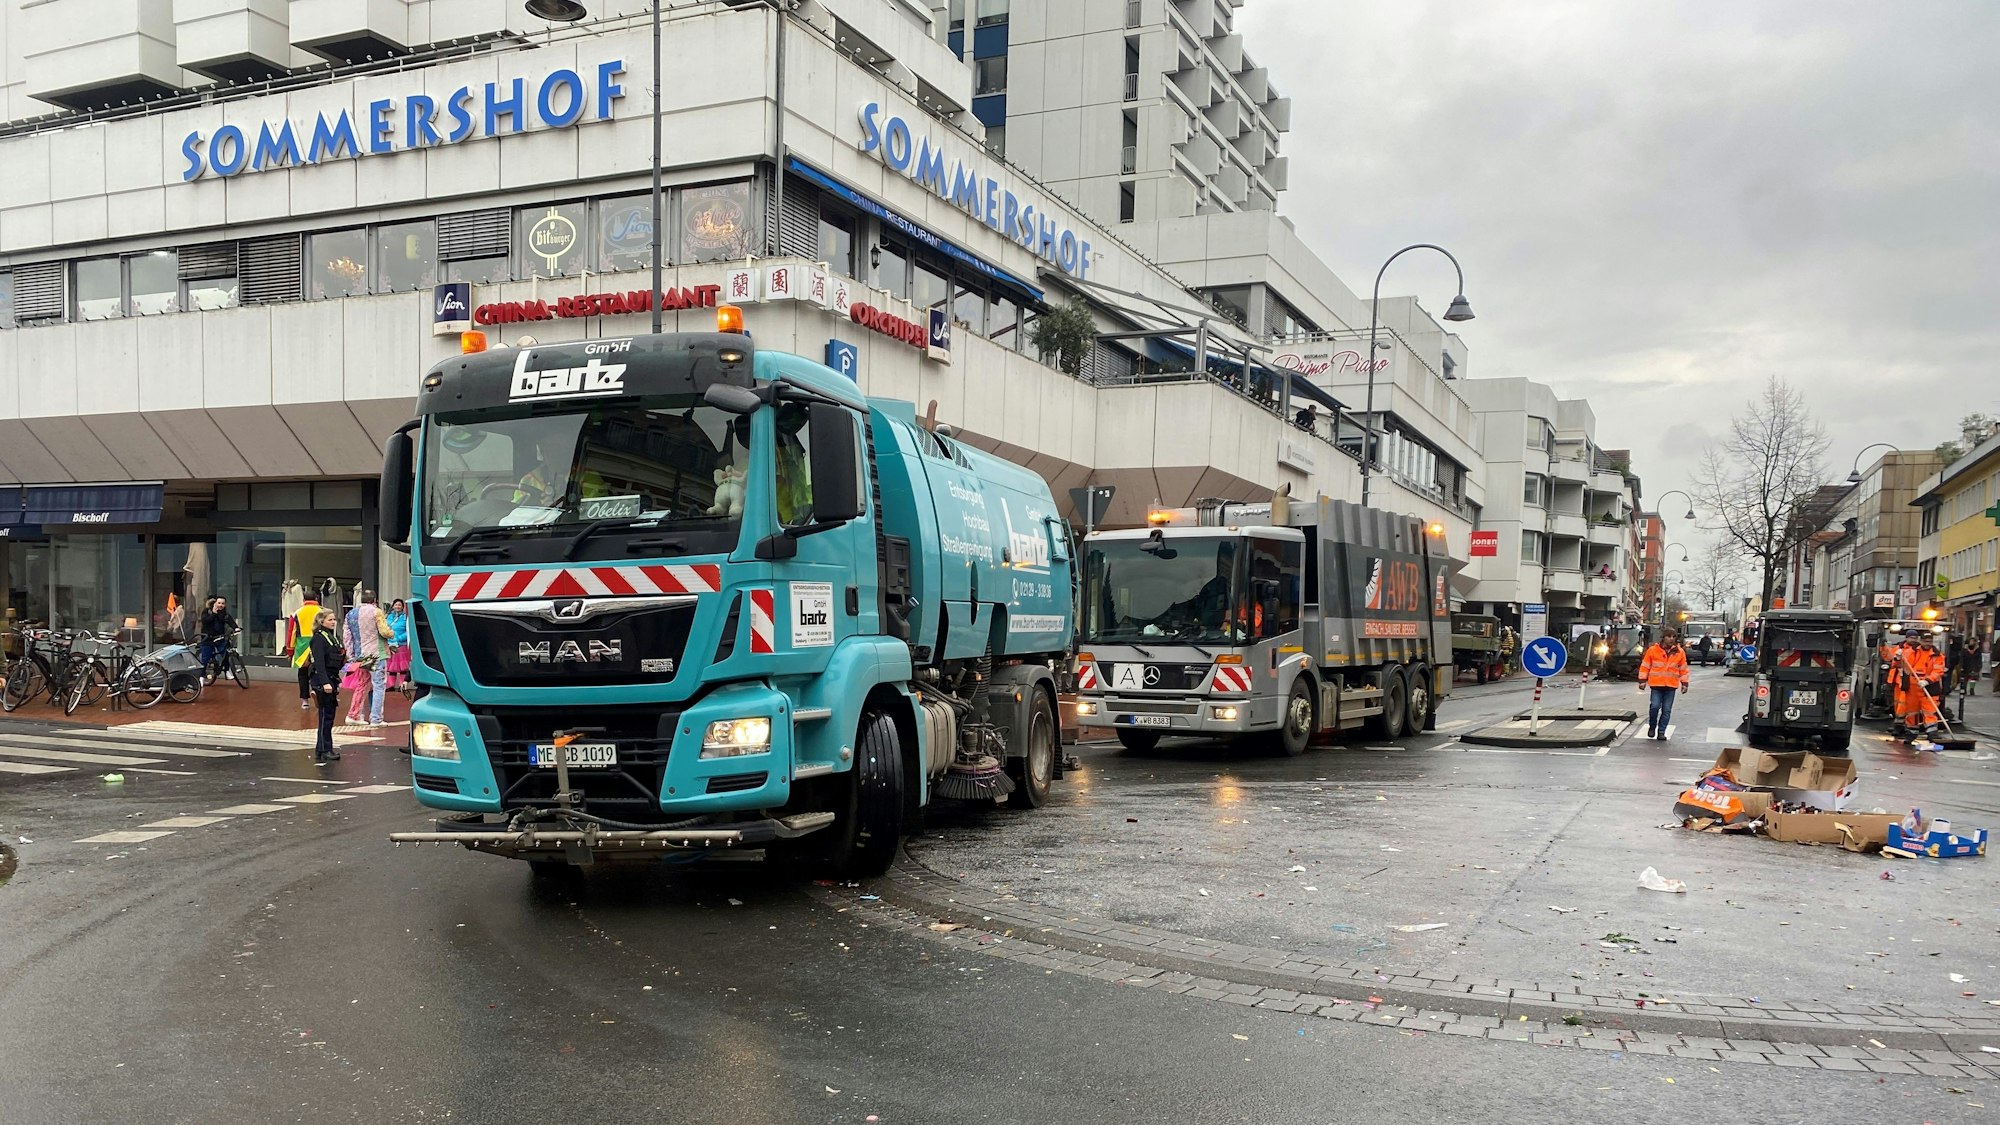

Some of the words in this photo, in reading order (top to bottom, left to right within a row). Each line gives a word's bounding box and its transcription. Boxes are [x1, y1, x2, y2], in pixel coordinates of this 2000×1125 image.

[182, 60, 627, 182] SOMMERSHOF
[858, 102, 1091, 279] SOMMERSHOF
[850, 191, 885, 215] CHINA
[885, 209, 943, 247] RESTAURANT
[436, 292, 466, 316] Sion
[584, 341, 631, 354] GmbH
[509, 350, 627, 398] bartz
[948, 481, 985, 509] Entsorgung
[72, 512, 110, 523] Bischoff
[587, 501, 632, 518] Obelix
[1384, 561, 1419, 612] AWB
[800, 600, 827, 625] bartz
[518, 639, 623, 664] MAN
[1119, 667, 1136, 686] A
[537, 747, 554, 762] ME
[582, 746, 613, 762] 1019
